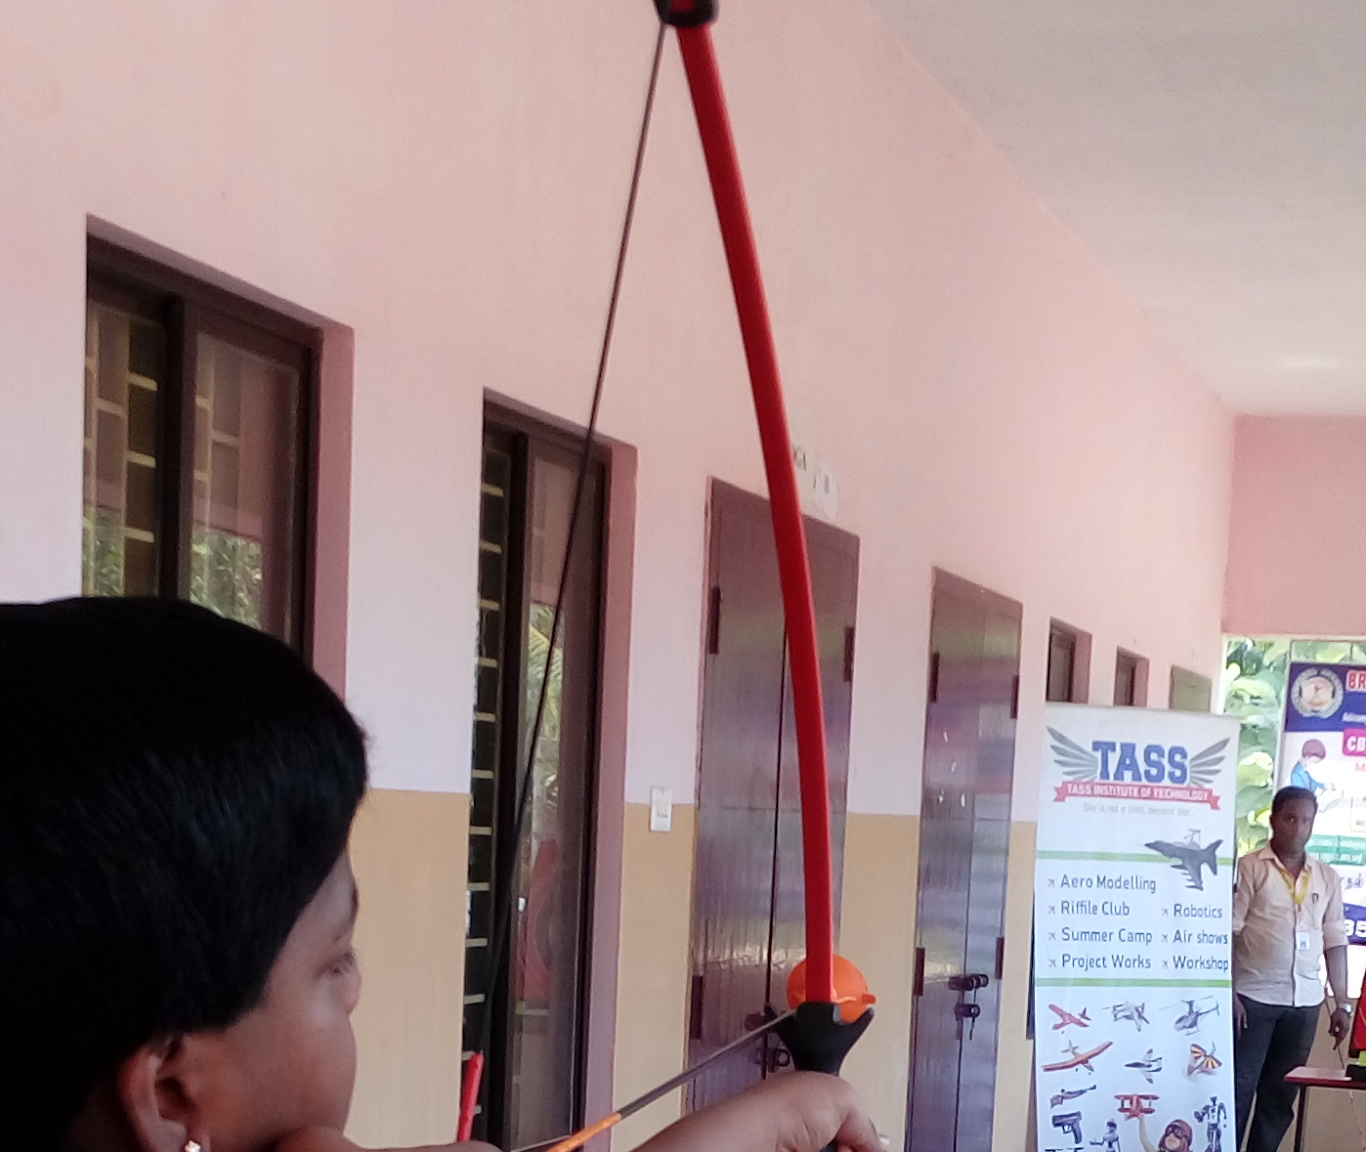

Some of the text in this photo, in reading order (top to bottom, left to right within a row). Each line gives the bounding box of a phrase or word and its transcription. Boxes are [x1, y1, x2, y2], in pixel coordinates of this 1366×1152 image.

[1092, 741, 1188, 784] TASS
[1067, 783, 1209, 801] TASS INSTITUTE OF TECHNOLOGY
[1060, 874, 1156, 894] Aero Modelling
[1102, 901, 1130, 916] Club
[1173, 903, 1223, 919] Robotics
[1062, 928, 1153, 946] Summer Camp
[1173, 930, 1228, 945] Air shows
[1062, 954, 1151, 971] Project Works
[1173, 956, 1229, 973] Workshop
